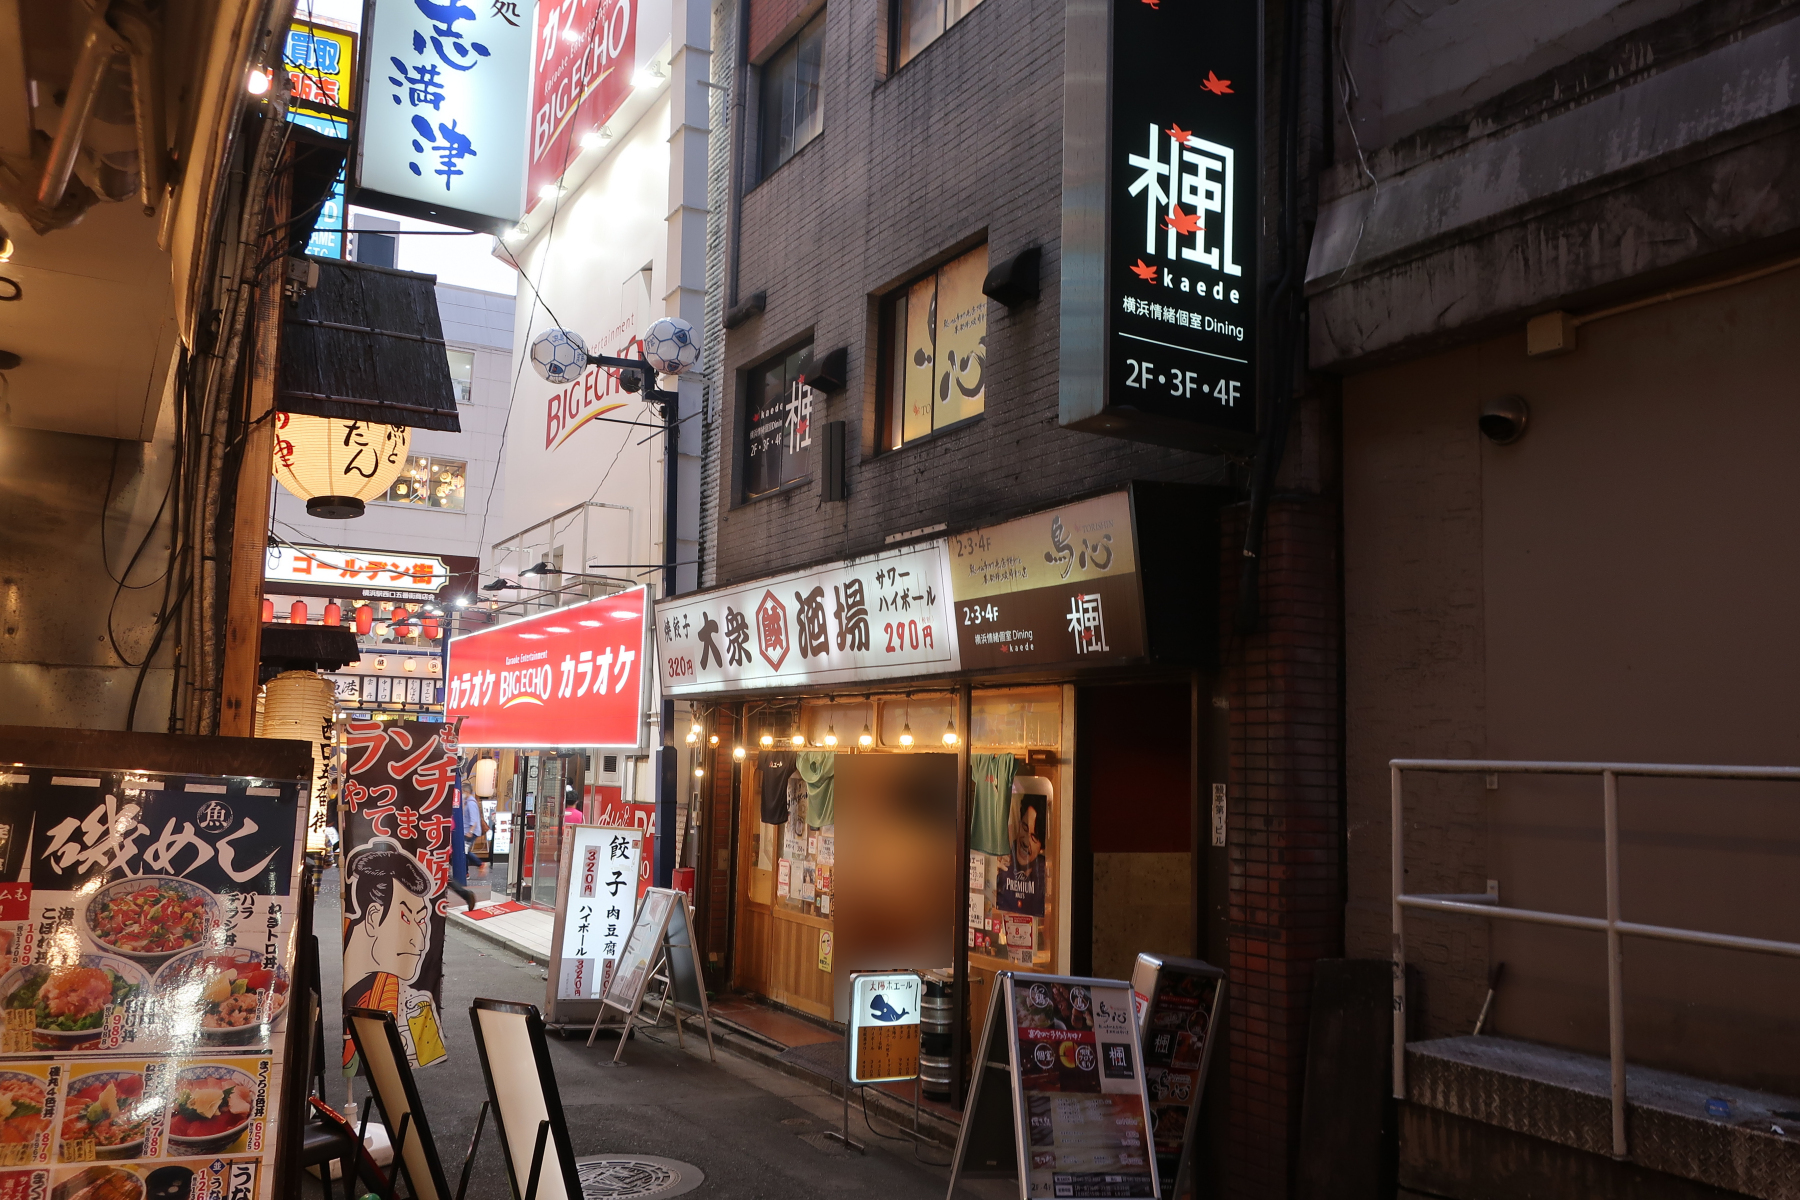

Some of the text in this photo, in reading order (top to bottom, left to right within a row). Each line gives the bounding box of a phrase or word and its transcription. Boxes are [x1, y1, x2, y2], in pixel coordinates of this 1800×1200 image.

[282, 31, 341, 74] 買取
[388, 0, 491, 191] 志満津
[534, 0, 631, 165] BIG ECHO
[1128, 123, 1242, 277] 楓
[310, 227, 336, 247] AME
[1163, 267, 1240, 304] kaede
[1122, 294, 1245, 342] 横浜情緒個室 Dining
[545, 380, 582, 451] BIG
[292, 553, 434, 585] ゴールデン街
[875, 566, 911, 590] サワー
[878, 585, 937, 613] ハイボール
[698, 605, 753, 671] 大衆
[794, 578, 870, 660] 酒場
[883, 619, 934, 654] 290円
[1012, 629, 1034, 642] Dining
[1066, 593, 1110, 655] 楓
[505, 649, 548, 666] Karaoke Entertainment
[667, 656, 694, 678] 320円
[1009, 643, 1035, 653] kaede
[449, 669, 497, 710] カラオケ
[499, 663, 553, 706] BIG ECHO
[557, 644, 636, 699] カラオケ
[200, 801, 229, 828] 魚
[584, 851, 597, 896] 320円
[605, 834, 628, 898] 餃子
[1006, 877, 1035, 895] PREMIUM
[20, 923, 34, 966] 1099
[575, 904, 593, 957] ハイボール
[603, 904, 620, 956] 肉豆腐
[110, 1014, 122, 1047] 989
[39, 1132, 50, 1163] 879
[149, 1127, 160, 1157] 789
[253, 1122, 262, 1151] 659
